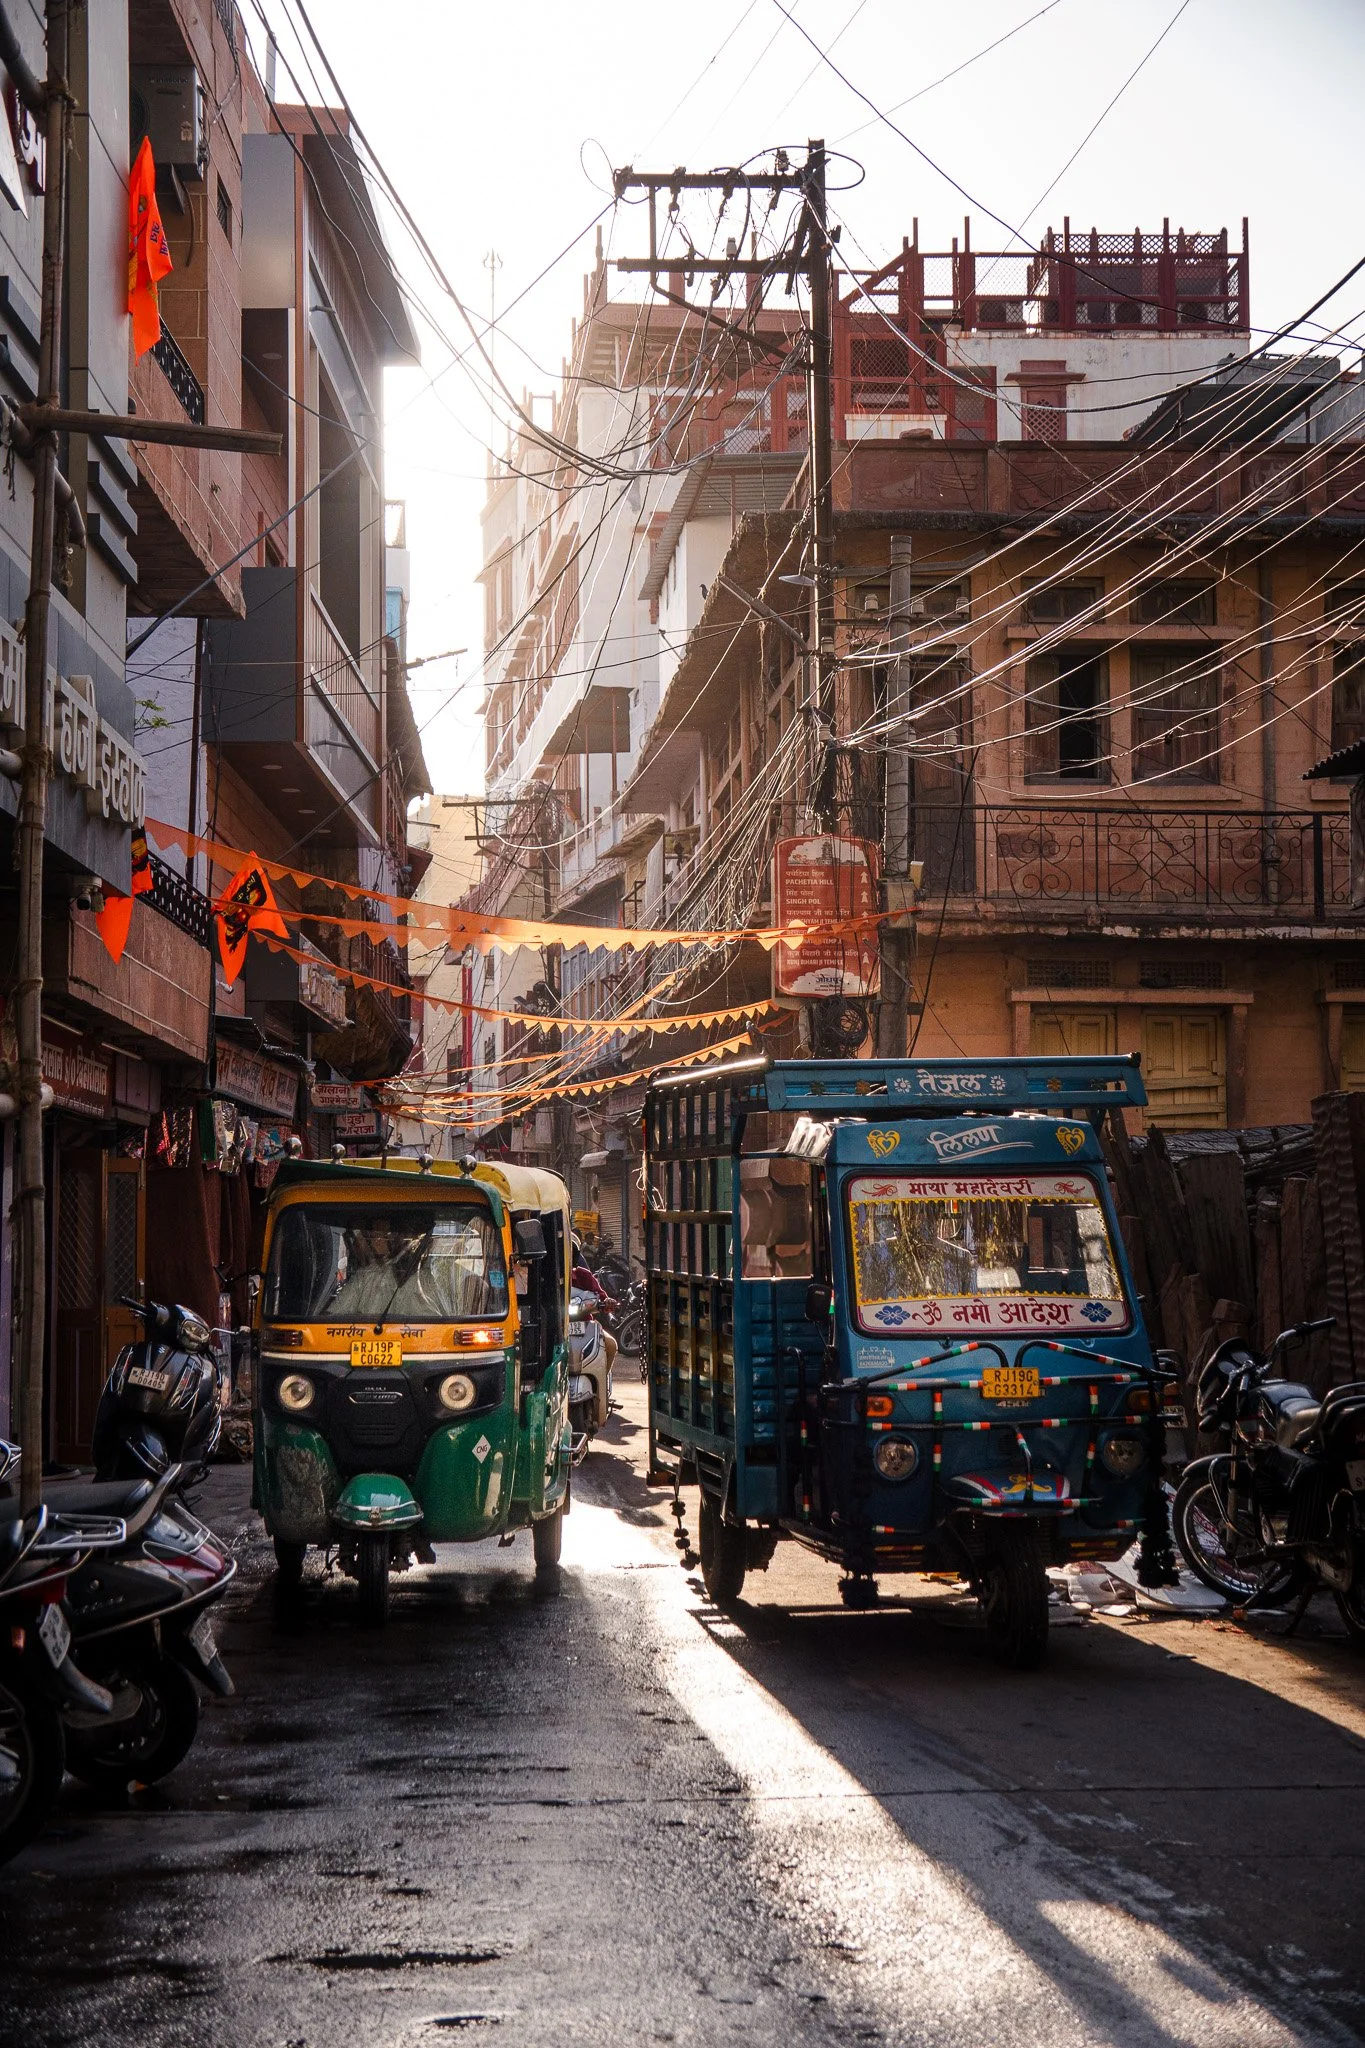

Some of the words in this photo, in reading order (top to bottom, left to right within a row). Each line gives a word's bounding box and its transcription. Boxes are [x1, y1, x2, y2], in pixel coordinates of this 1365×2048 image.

[60, 675, 98, 790] हाजी
[916, 1069, 987, 1094] तेजल
[908, 1182, 948, 1196] माया
[950, 1298, 991, 1324] नमो
[998, 1298, 1074, 1326] आदेश
[327, 1324, 366, 1338] नगरीय
[360, 1341, 394, 1353] RJ19P
[360, 1353, 394, 1365] C0622
[994, 1369, 1033, 1382] RJ19G
[994, 1383, 1033, 1396] G3314
[476, 1445, 488, 1453] CNG
